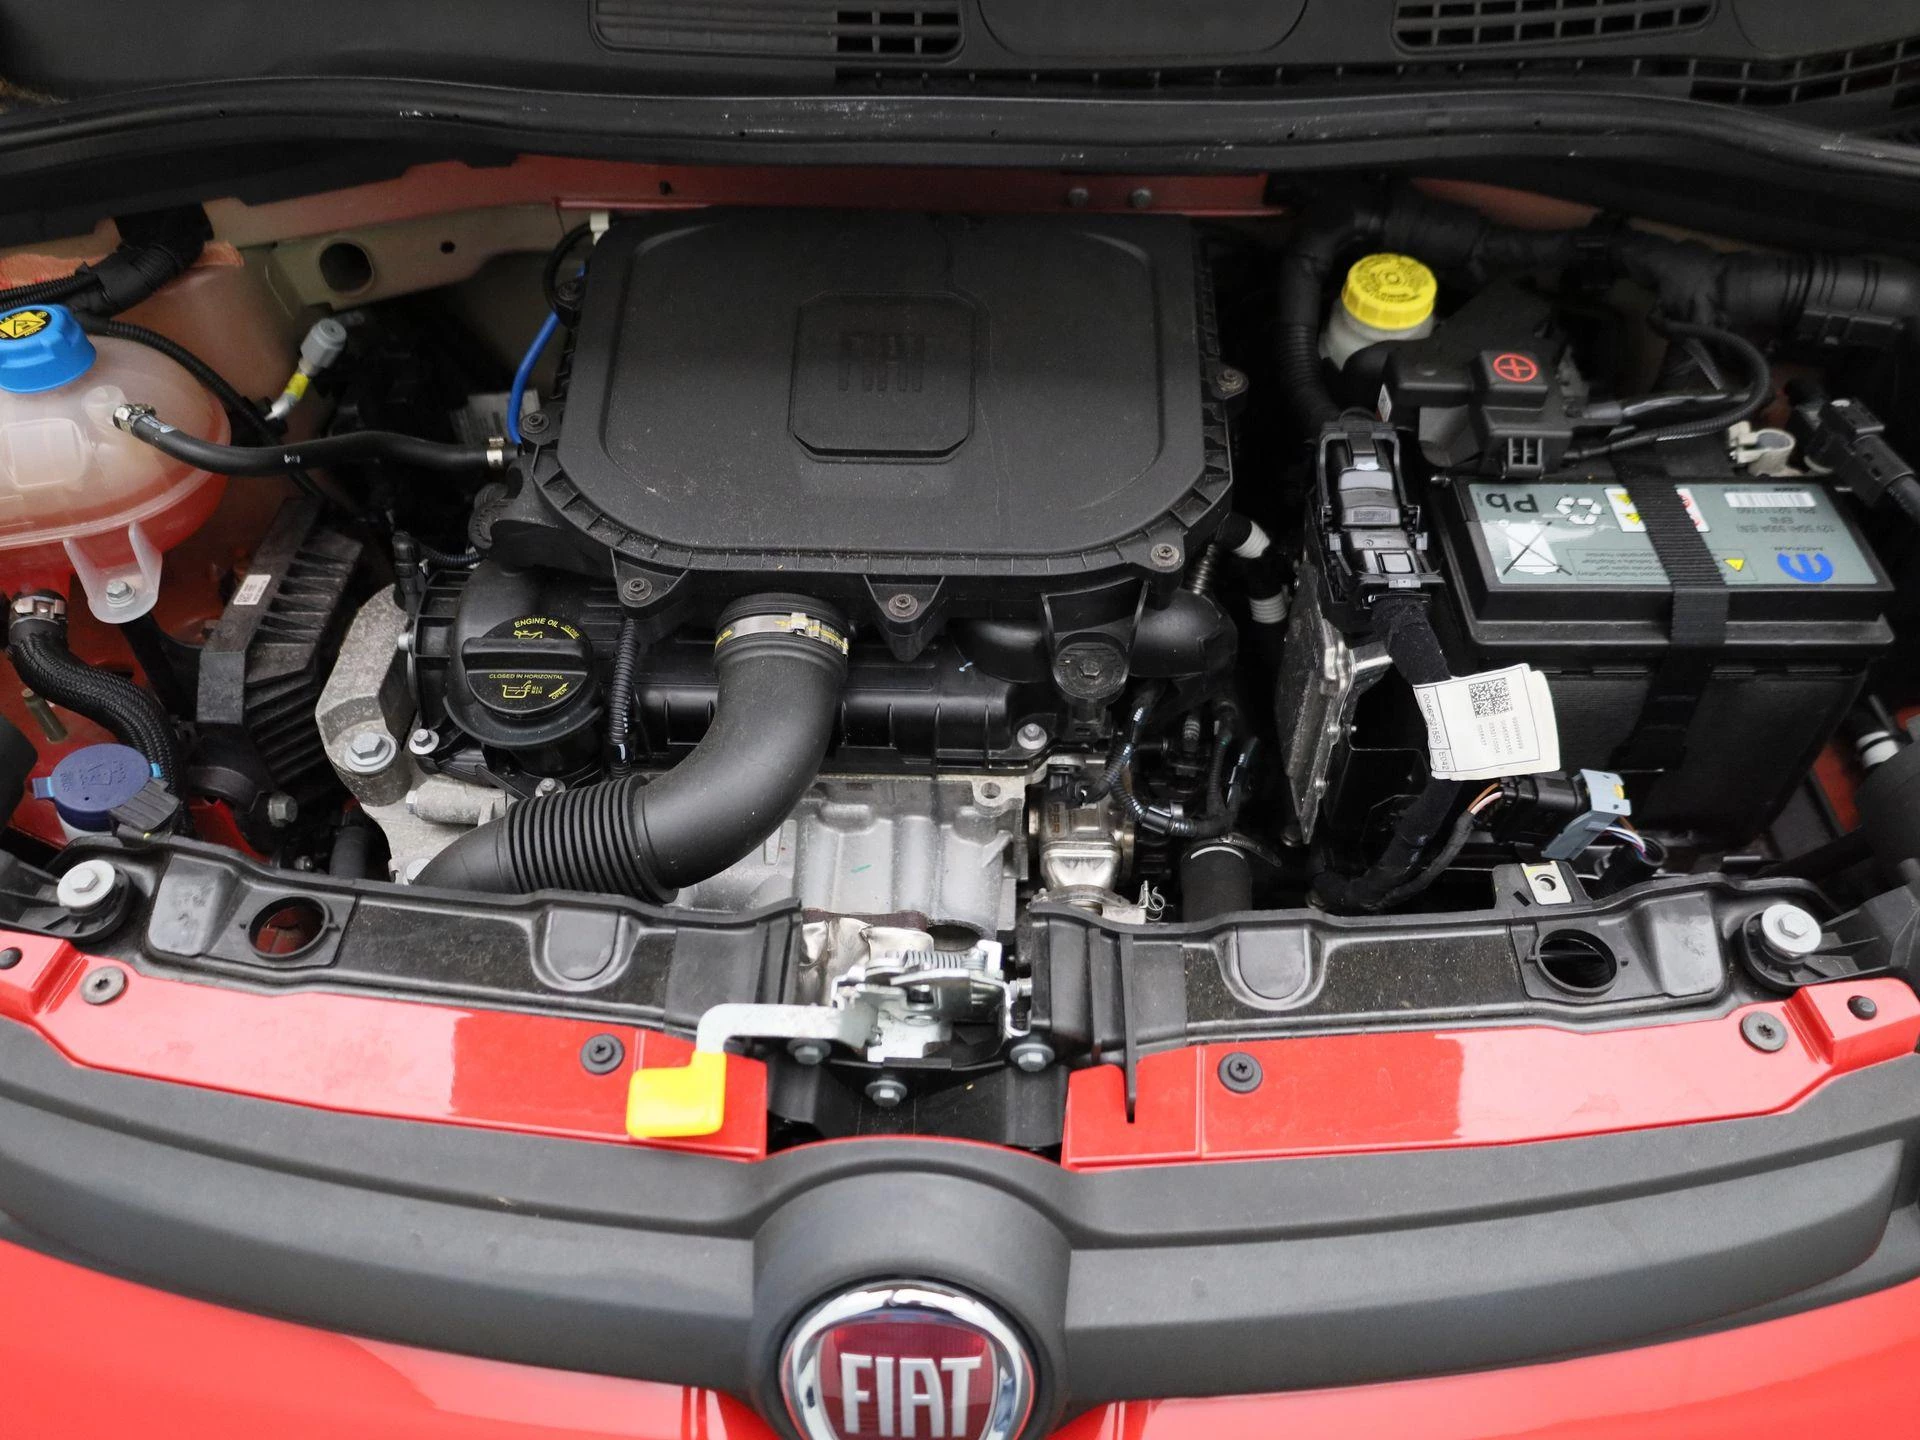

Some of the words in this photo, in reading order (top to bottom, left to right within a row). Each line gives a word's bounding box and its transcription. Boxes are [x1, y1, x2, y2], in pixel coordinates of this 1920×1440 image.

[1485, 493, 1539, 513] Pb
[514, 618, 547, 628] ENGINE
[547, 619, 560, 628] OIL
[564, 624, 580, 639] CLOSE
[551, 687, 568, 700] OPEN
[840, 1352, 982, 1439] FIAT
